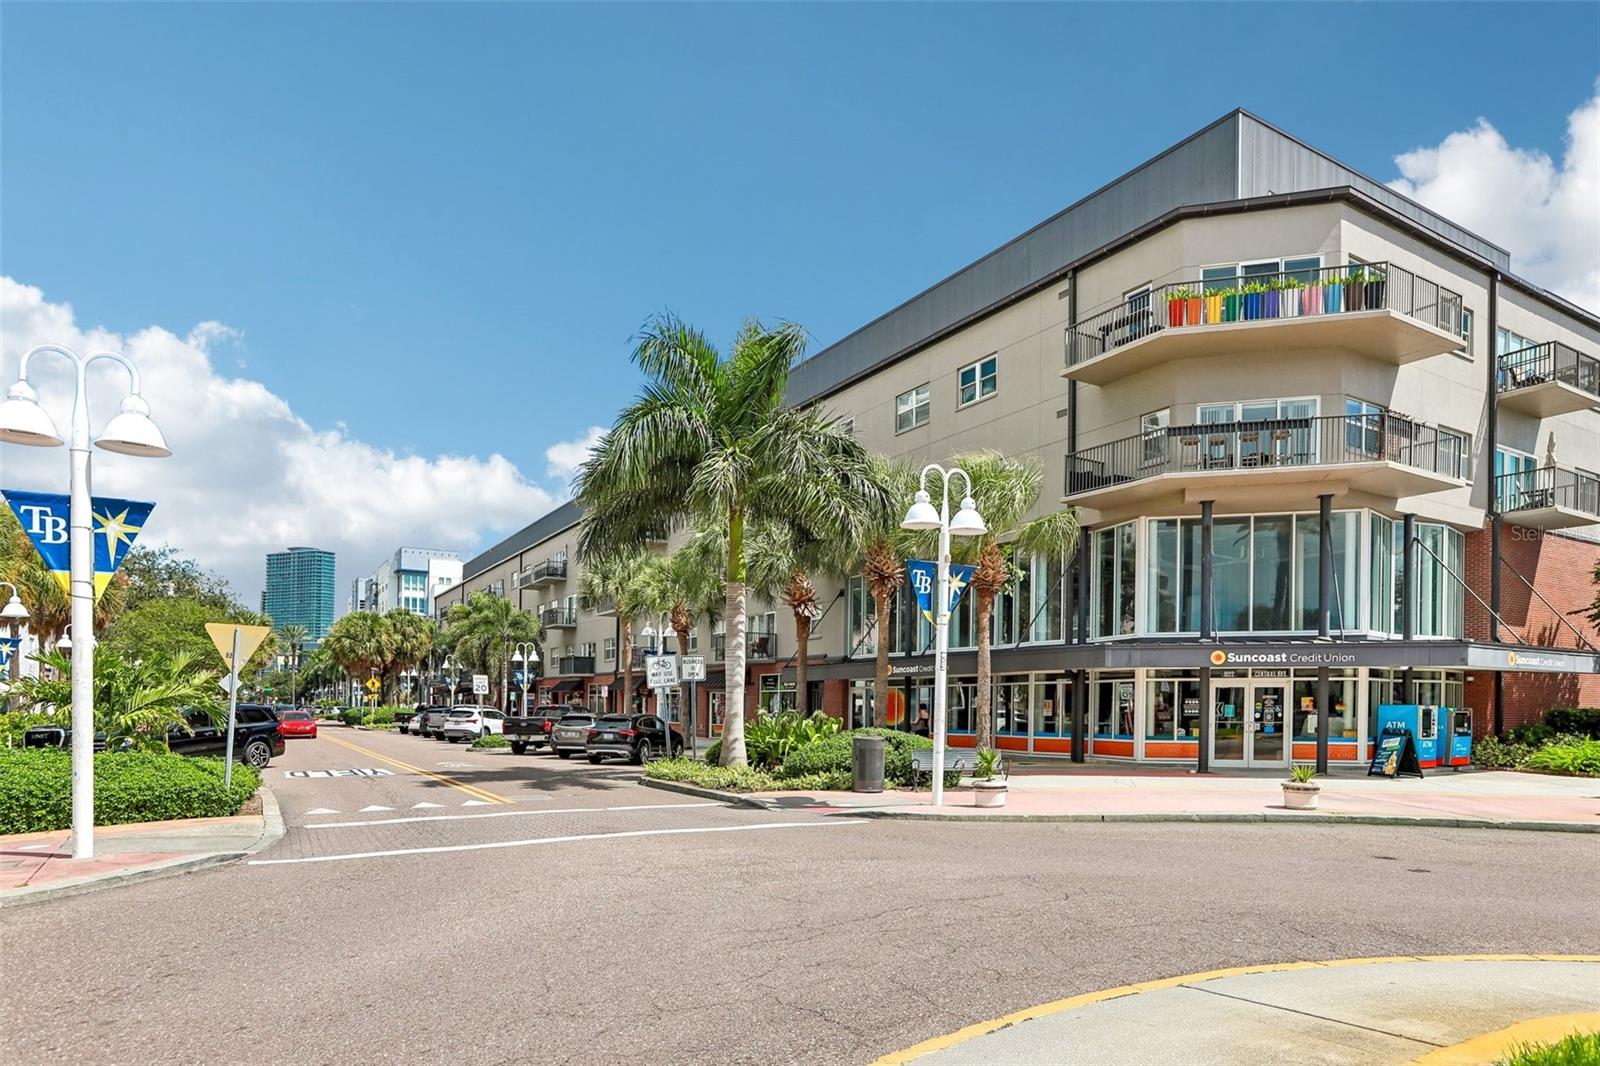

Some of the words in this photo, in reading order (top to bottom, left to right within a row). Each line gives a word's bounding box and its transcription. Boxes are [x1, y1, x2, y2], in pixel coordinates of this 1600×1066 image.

[19, 505, 69, 544] TB
[912, 569, 932, 594] TB
[1227, 652, 1288, 663] Suncoast
[1289, 653, 1322, 663] Credit
[1323, 653, 1356, 663] Union
[892, 665, 919, 674] Suncoast
[475, 684, 488, 692] 20
[1386, 721, 1406, 729] ATM
